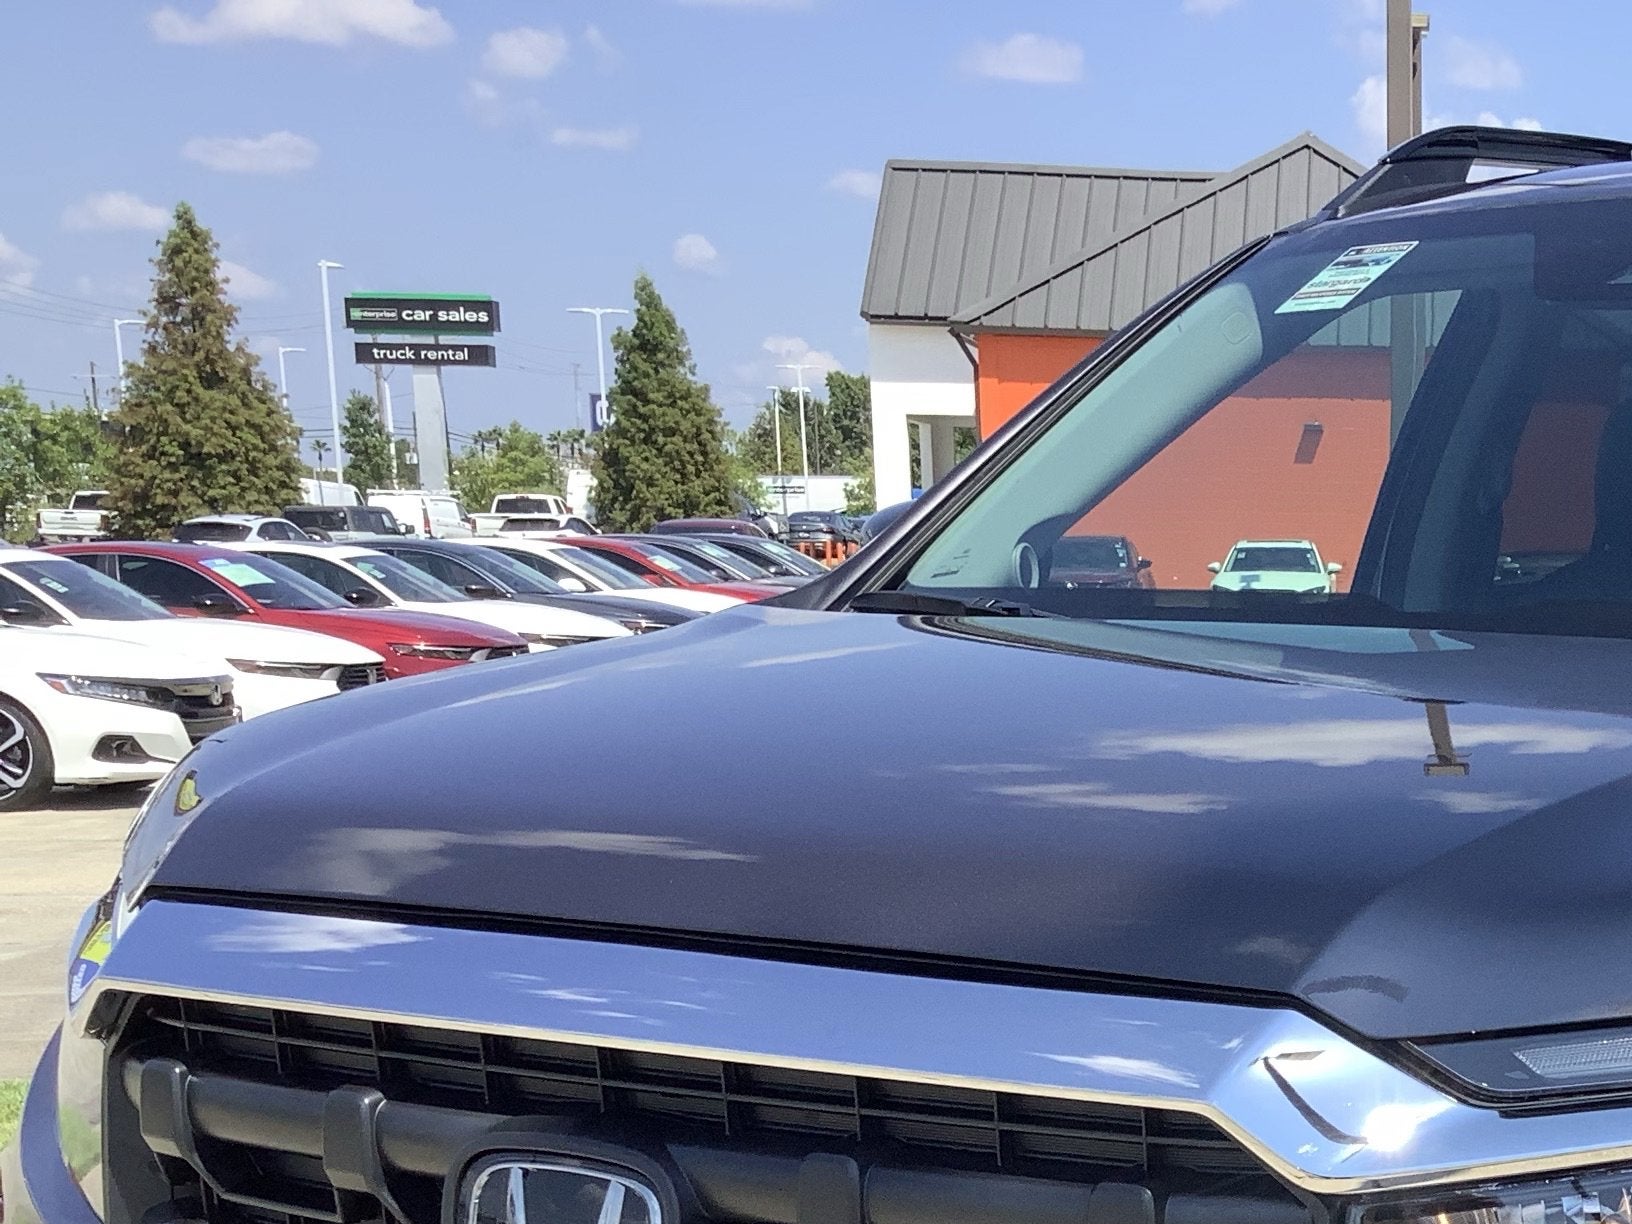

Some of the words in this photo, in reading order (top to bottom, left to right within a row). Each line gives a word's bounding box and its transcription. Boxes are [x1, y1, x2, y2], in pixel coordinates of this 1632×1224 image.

[401, 309, 433, 321] car
[437, 307, 489, 323] sales
[372, 346, 415, 360] truck
[420, 347, 469, 361] rental
